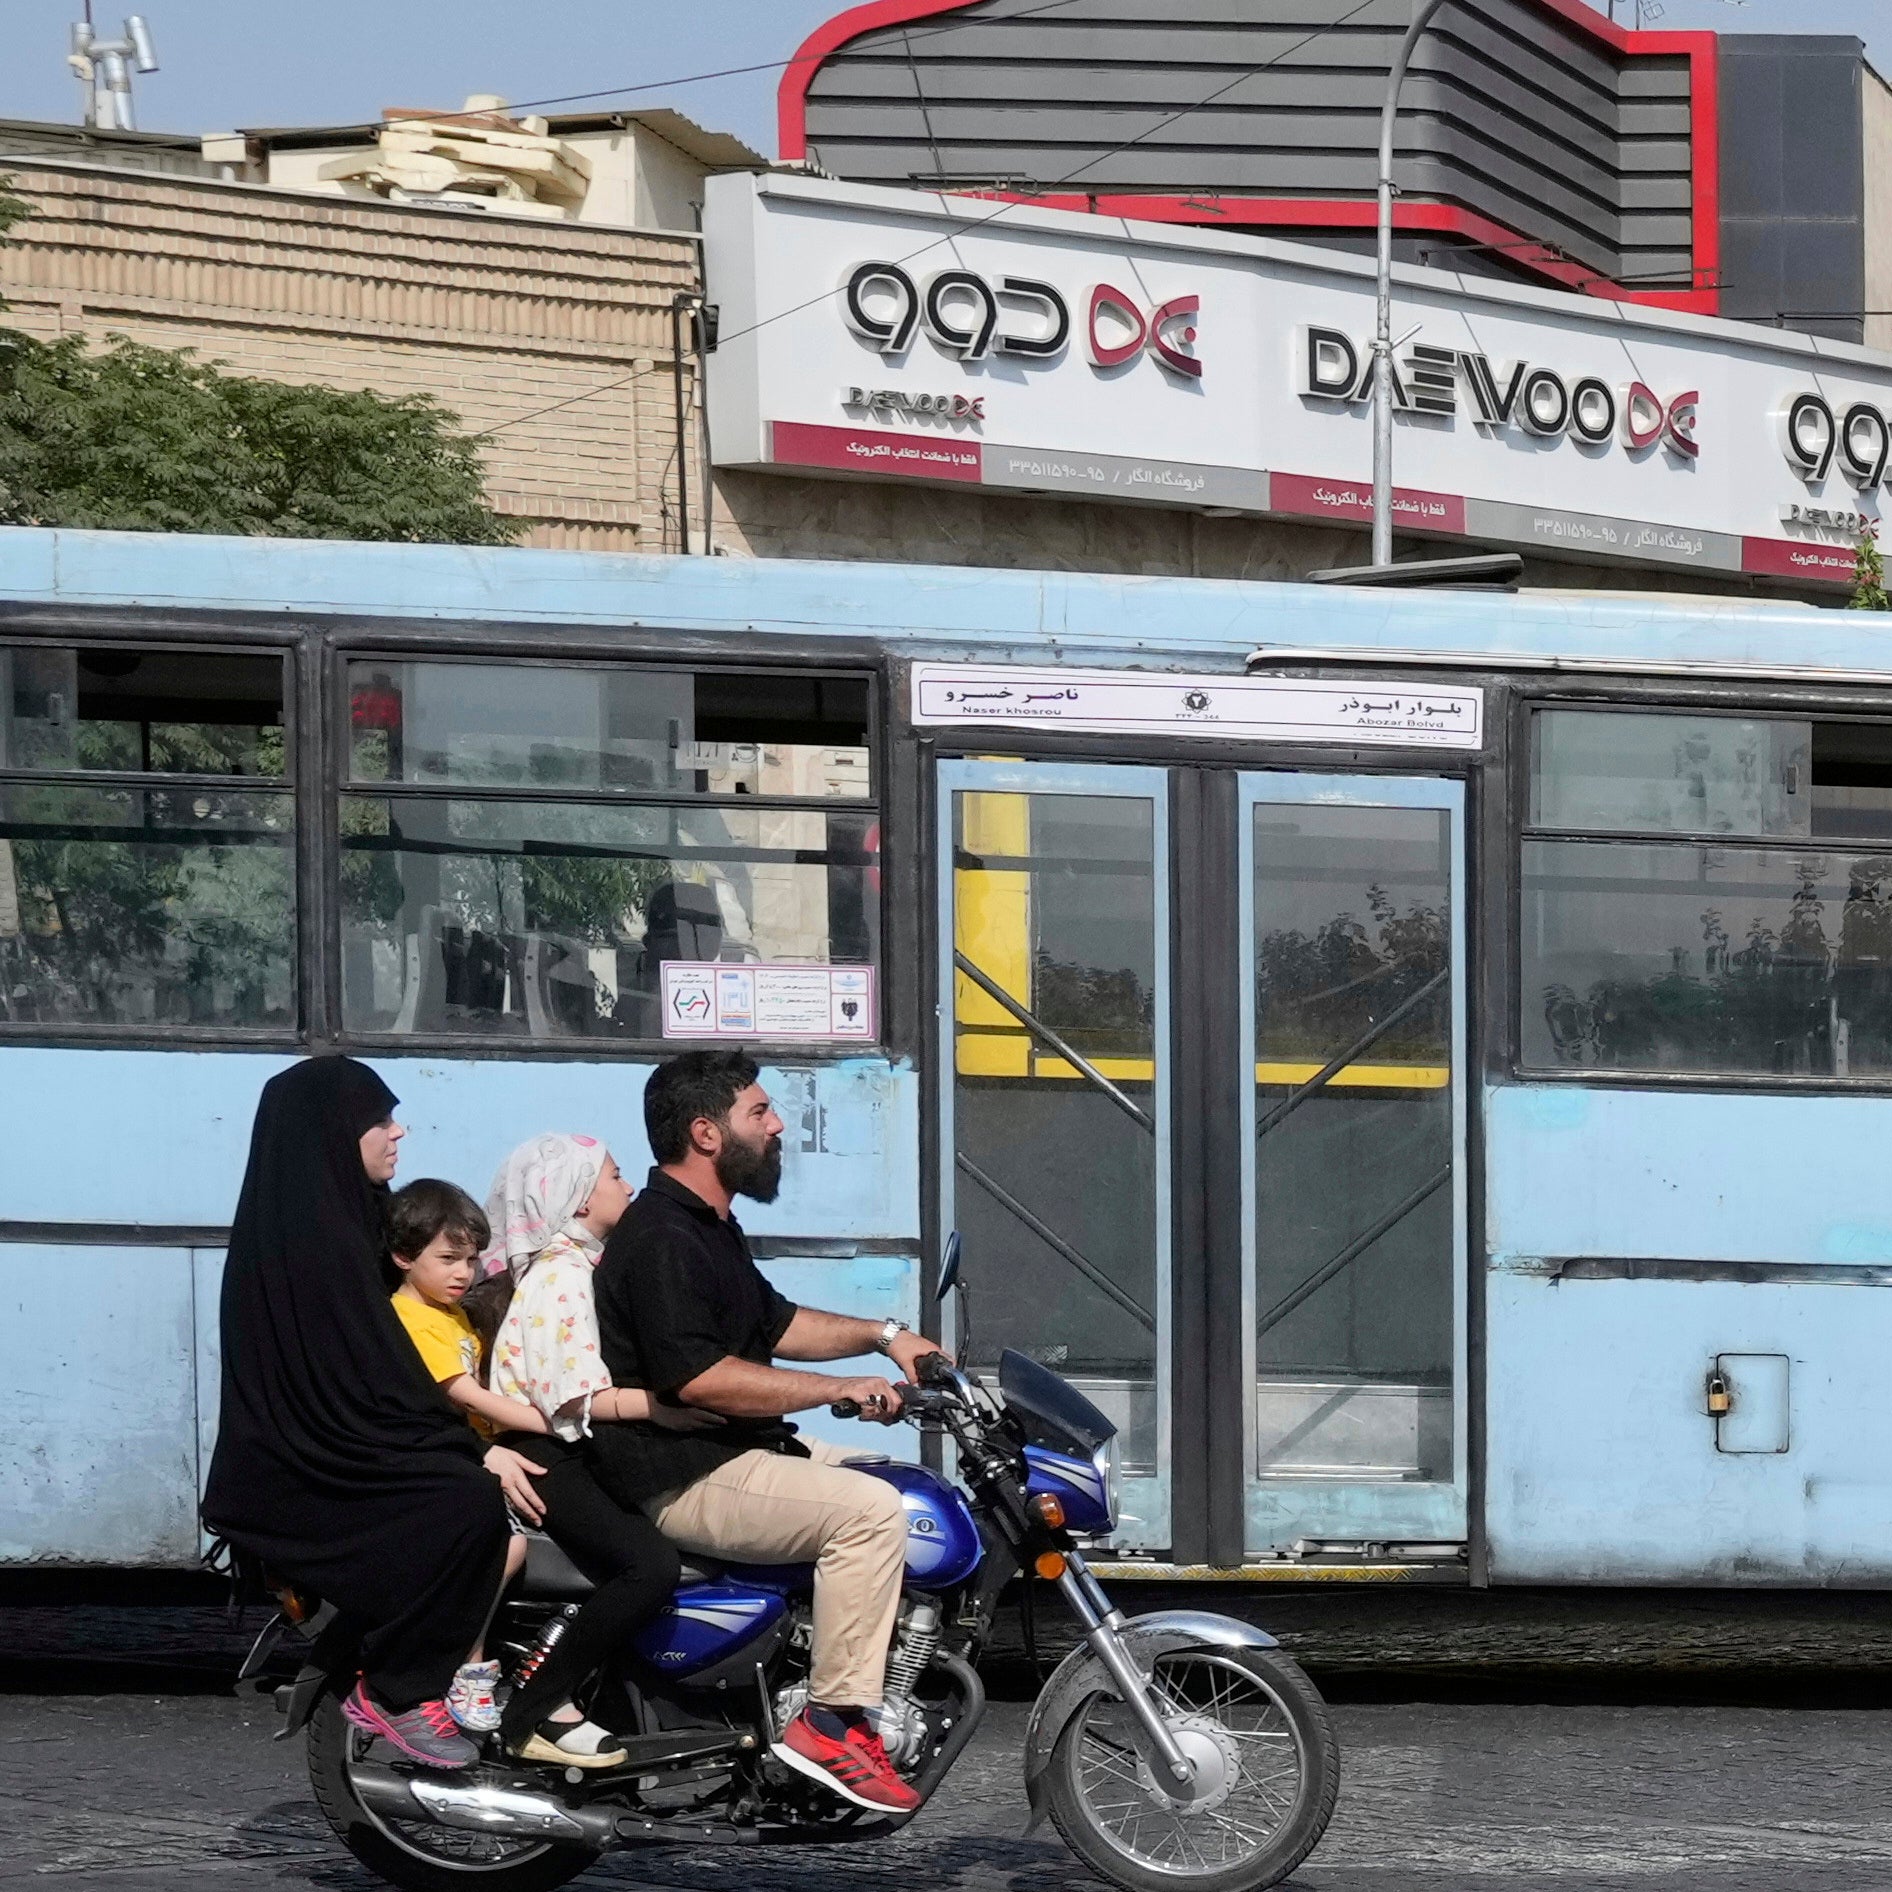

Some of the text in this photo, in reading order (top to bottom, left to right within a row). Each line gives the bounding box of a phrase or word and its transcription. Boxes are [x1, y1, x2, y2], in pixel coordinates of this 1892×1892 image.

[1305, 325, 1617, 444] DAEWOO
[1154, 469, 1205, 492] فروشگاه
[1658, 531, 1704, 556] فروشگاه
[944, 685, 1079, 704] ناصر خسرو
[962, 704, 1062, 717] Naser khosrou
[1339, 696, 1462, 718] بلوار ابوذر
[1356, 717, 1402, 727] Abozar
